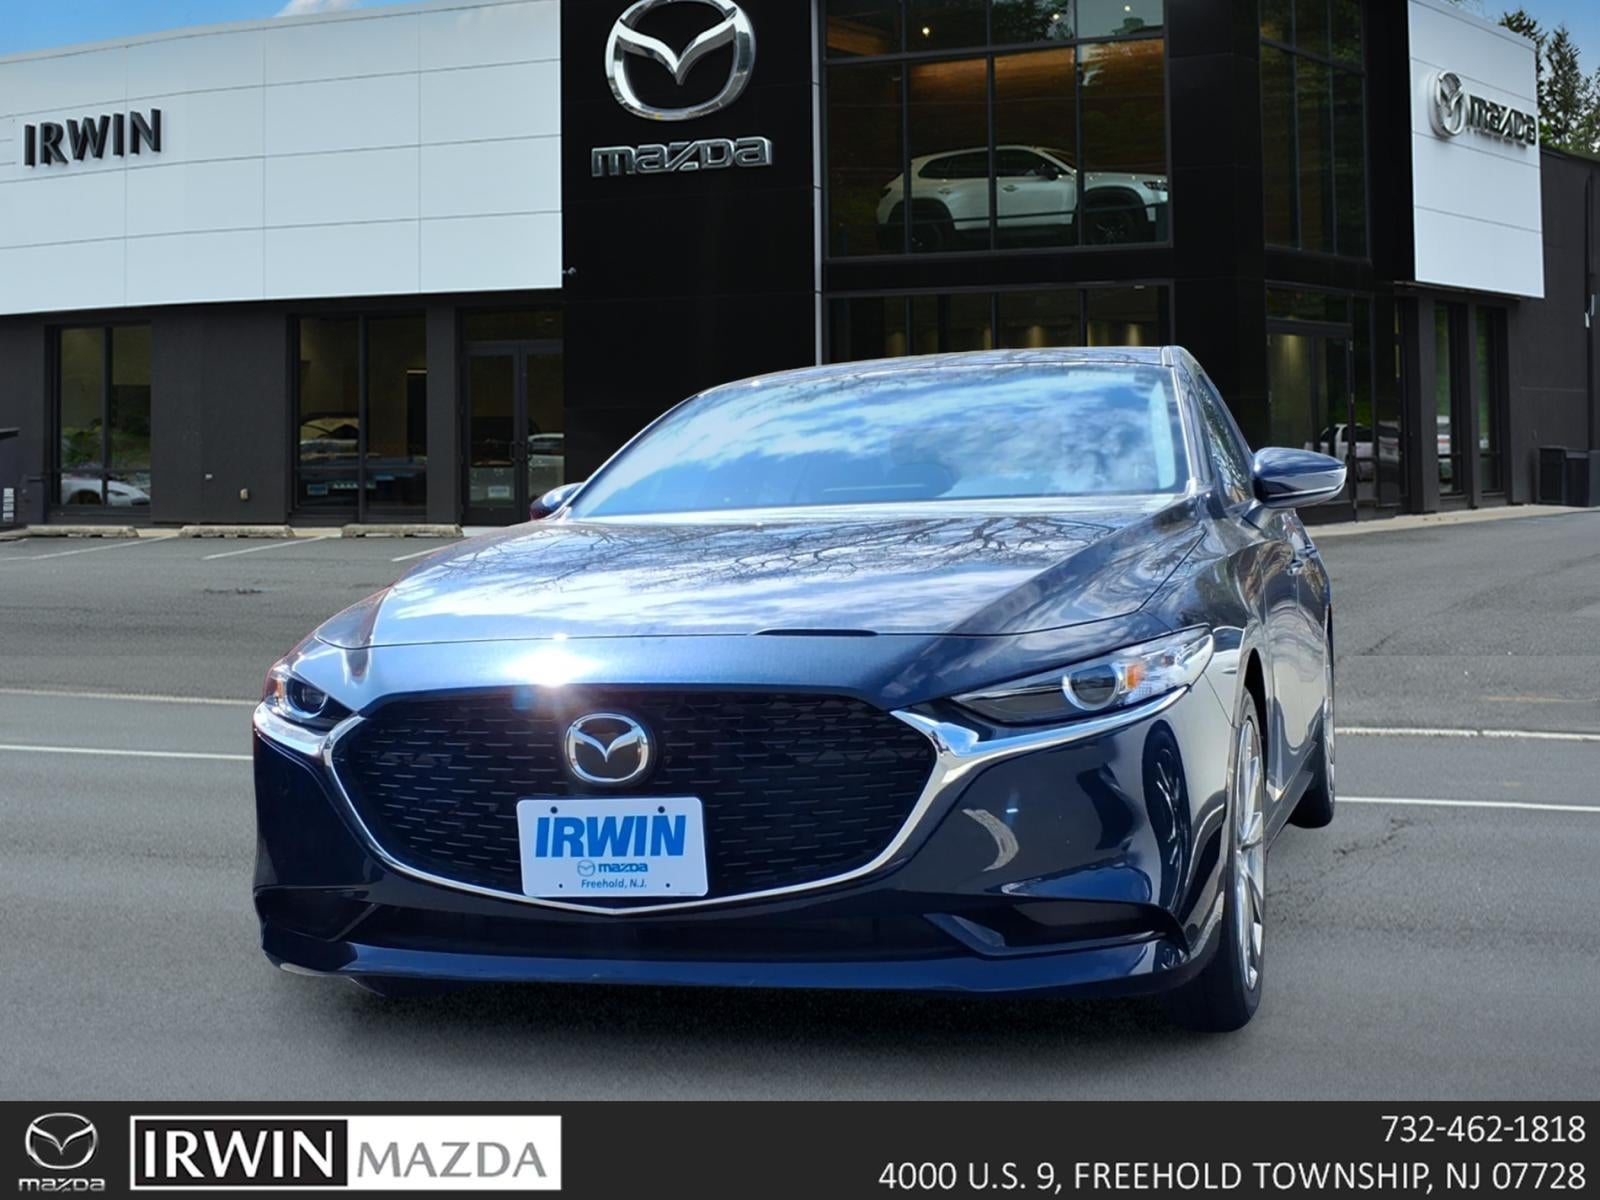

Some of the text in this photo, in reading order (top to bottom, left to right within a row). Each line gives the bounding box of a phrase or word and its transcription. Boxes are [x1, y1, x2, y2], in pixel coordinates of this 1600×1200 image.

[24, 108, 162, 167] IRWIN
[535, 815, 686, 858] IRWIN
[581, 878, 648, 889] Freehold, N.J.
